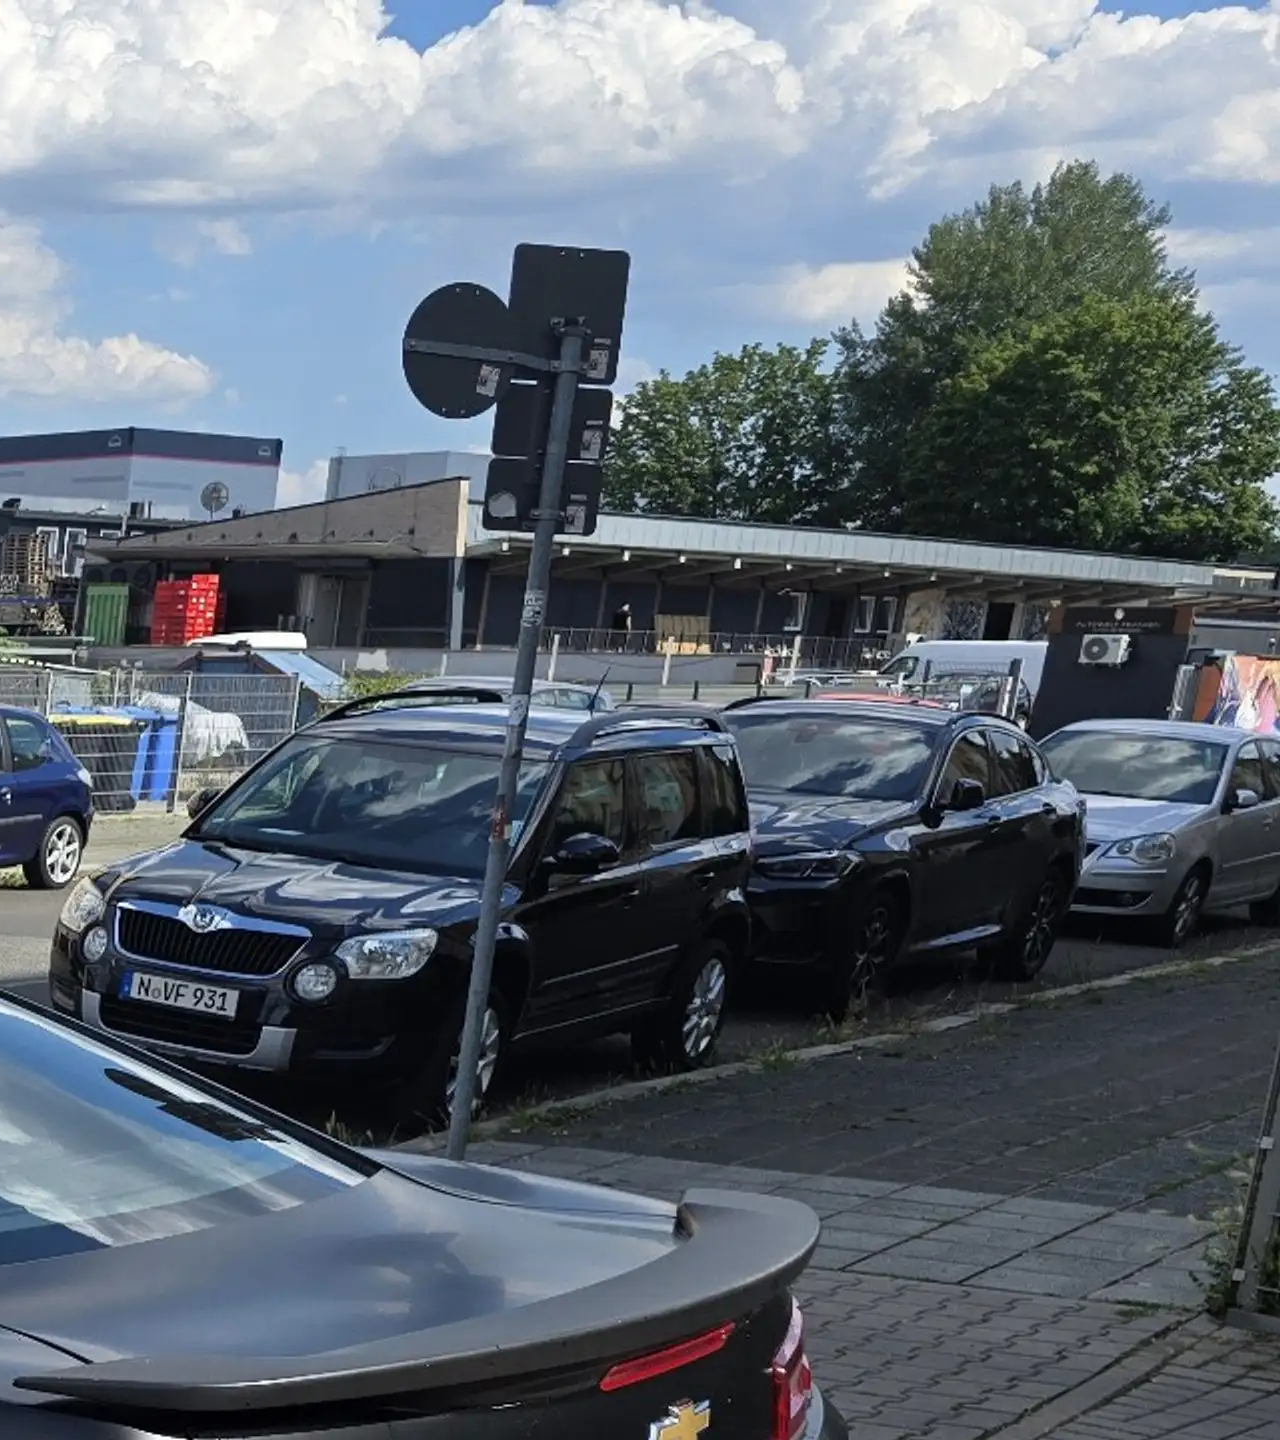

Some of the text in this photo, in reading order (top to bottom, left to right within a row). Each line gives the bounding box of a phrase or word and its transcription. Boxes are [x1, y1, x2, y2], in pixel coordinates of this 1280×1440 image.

[137, 976, 228, 1012] N VF 931
